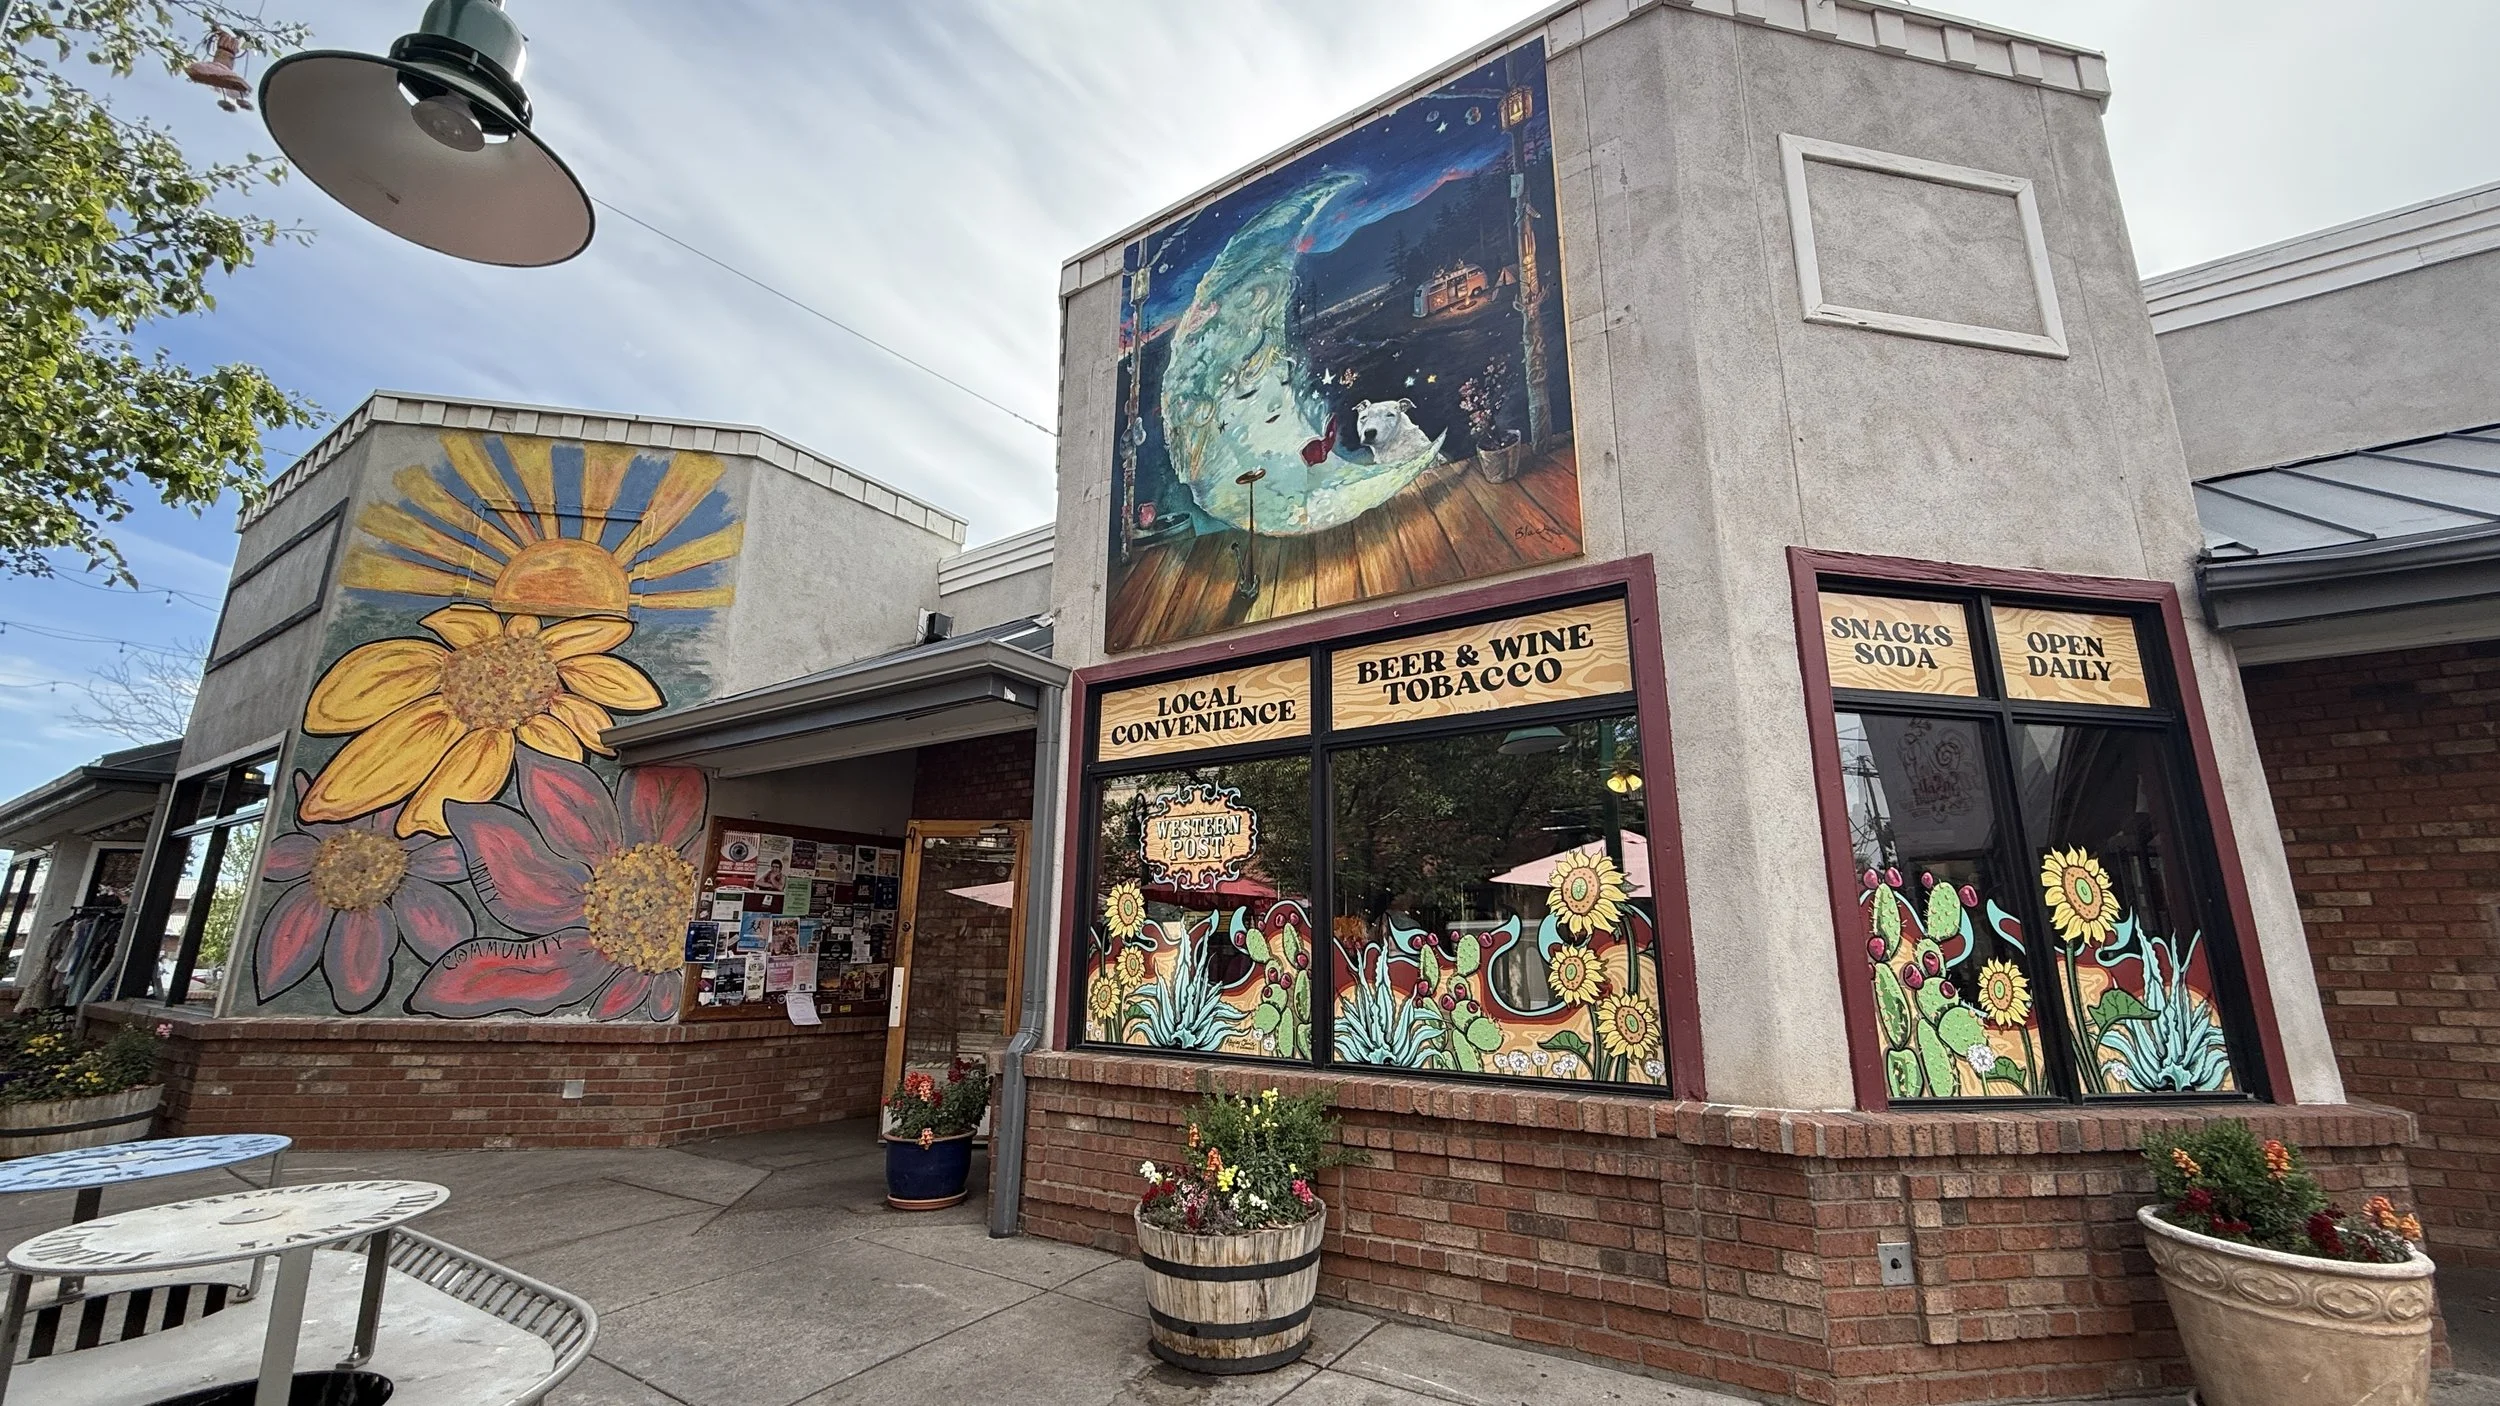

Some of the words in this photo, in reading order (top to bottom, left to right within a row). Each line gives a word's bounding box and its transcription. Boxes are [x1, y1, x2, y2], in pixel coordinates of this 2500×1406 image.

[1830, 616, 1953, 647] SNACKS
[2027, 631, 2105, 658] OPEN
[1357, 648, 1448, 685] BEER
[1456, 643, 1479, 670] &
[1488, 623, 1594, 661] WINE
[1854, 642, 1938, 670] SODA
[2026, 655, 2112, 682] DAILY
[1383, 657, 1563, 706] TOBACCO
[1158, 685, 1242, 718] LOCAL
[1111, 698, 1297, 746] CONVENIENCE
[1155, 813, 1241, 840] WESTERN
[1169, 835, 1225, 861] POST
[470, 856, 502, 904] UNITY
[442, 934, 563, 970] COMMUNITY
[237, 1189, 440, 1249] LANDFILL
